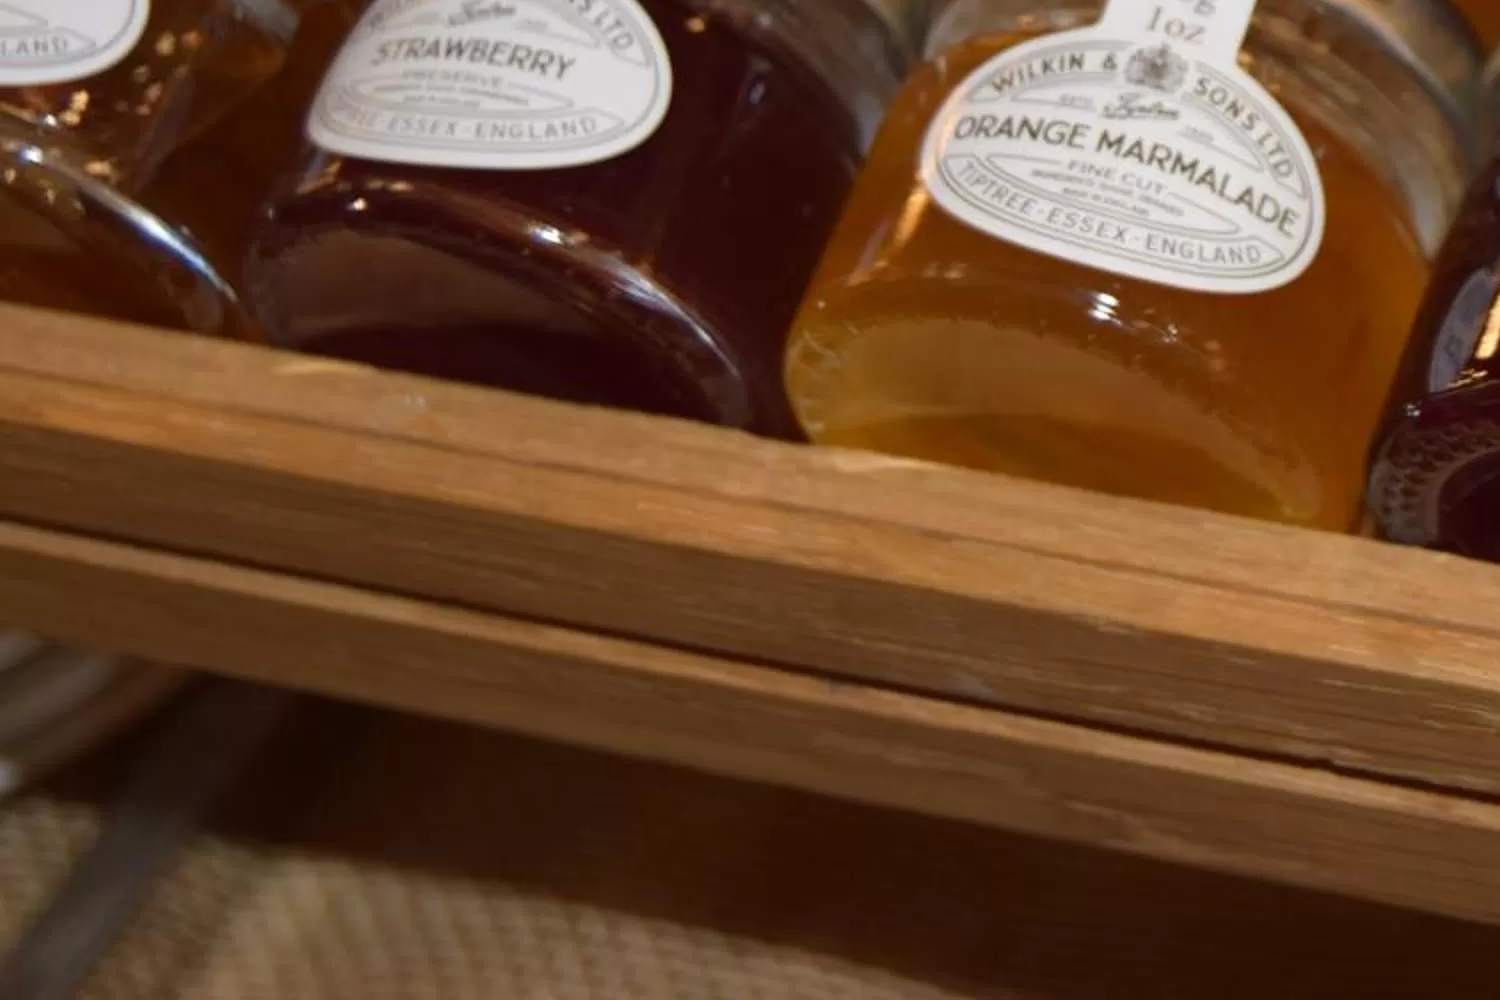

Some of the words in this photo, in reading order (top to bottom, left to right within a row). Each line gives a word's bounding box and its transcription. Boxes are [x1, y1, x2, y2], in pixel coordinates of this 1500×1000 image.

[371, 35, 576, 80] STRAWBERRY
[1144, 6, 1206, 46] 1oz
[990, 52, 1086, 93] WILKIN
[1102, 55, 1118, 71] &
[1196, 77, 1262, 134] SONS
[1256, 131, 1295, 179] LTD
[954, 115, 1091, 149] ORANGE
[1096, 128, 1299, 239] MARMALADE
[956, 158, 1037, 218] TIPTREE
[1045, 206, 1131, 245] ESSEX
[1145, 233, 1262, 267] ENGLAND
